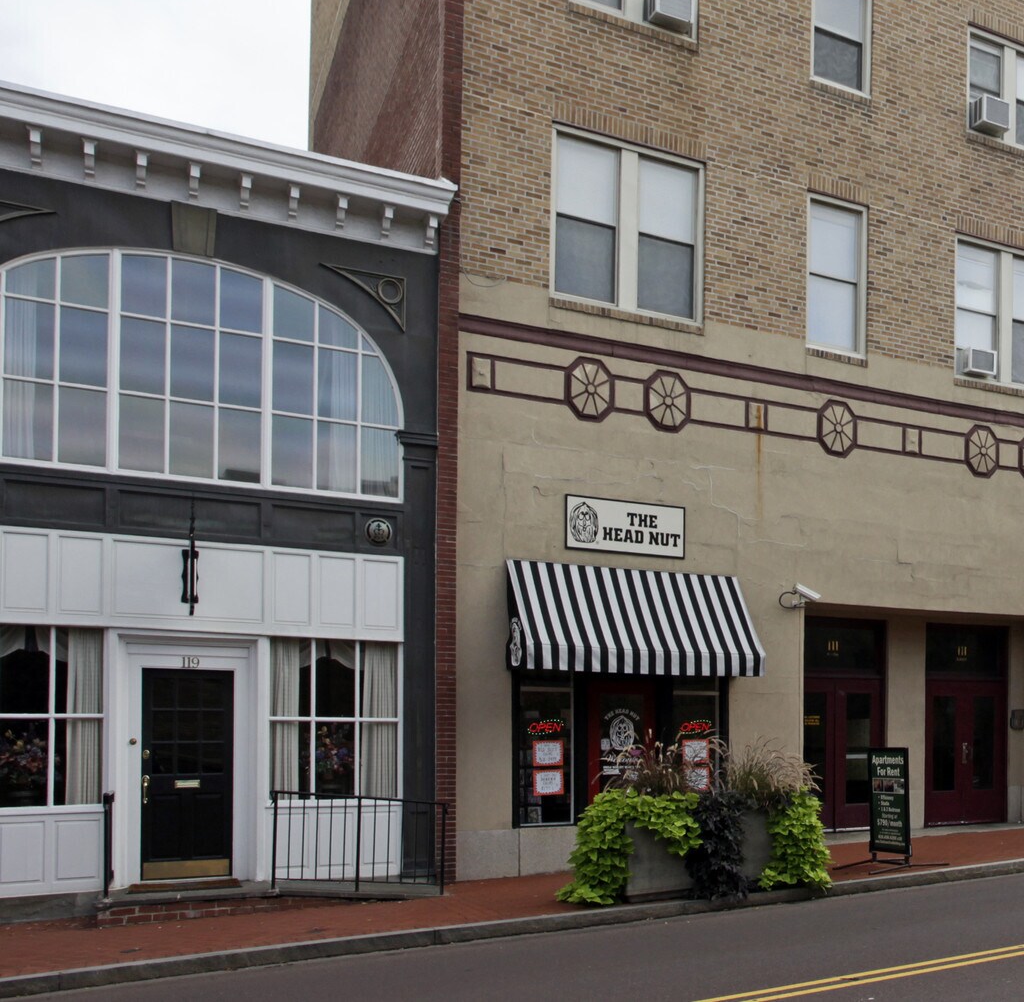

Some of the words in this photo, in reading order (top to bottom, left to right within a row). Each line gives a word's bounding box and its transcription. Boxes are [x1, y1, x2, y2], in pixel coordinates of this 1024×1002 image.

[627, 512, 658, 529] THE
[602, 526, 644, 544] HEAD
[648, 531, 681, 548] NUT
[181, 656, 200, 669] 119
[529, 722, 561, 733] OPEN
[681, 722, 709, 732] OPEN
[872, 755, 904, 766] Apartments
[877, 766, 886, 776] For
[886, 766, 900, 777] Rent
